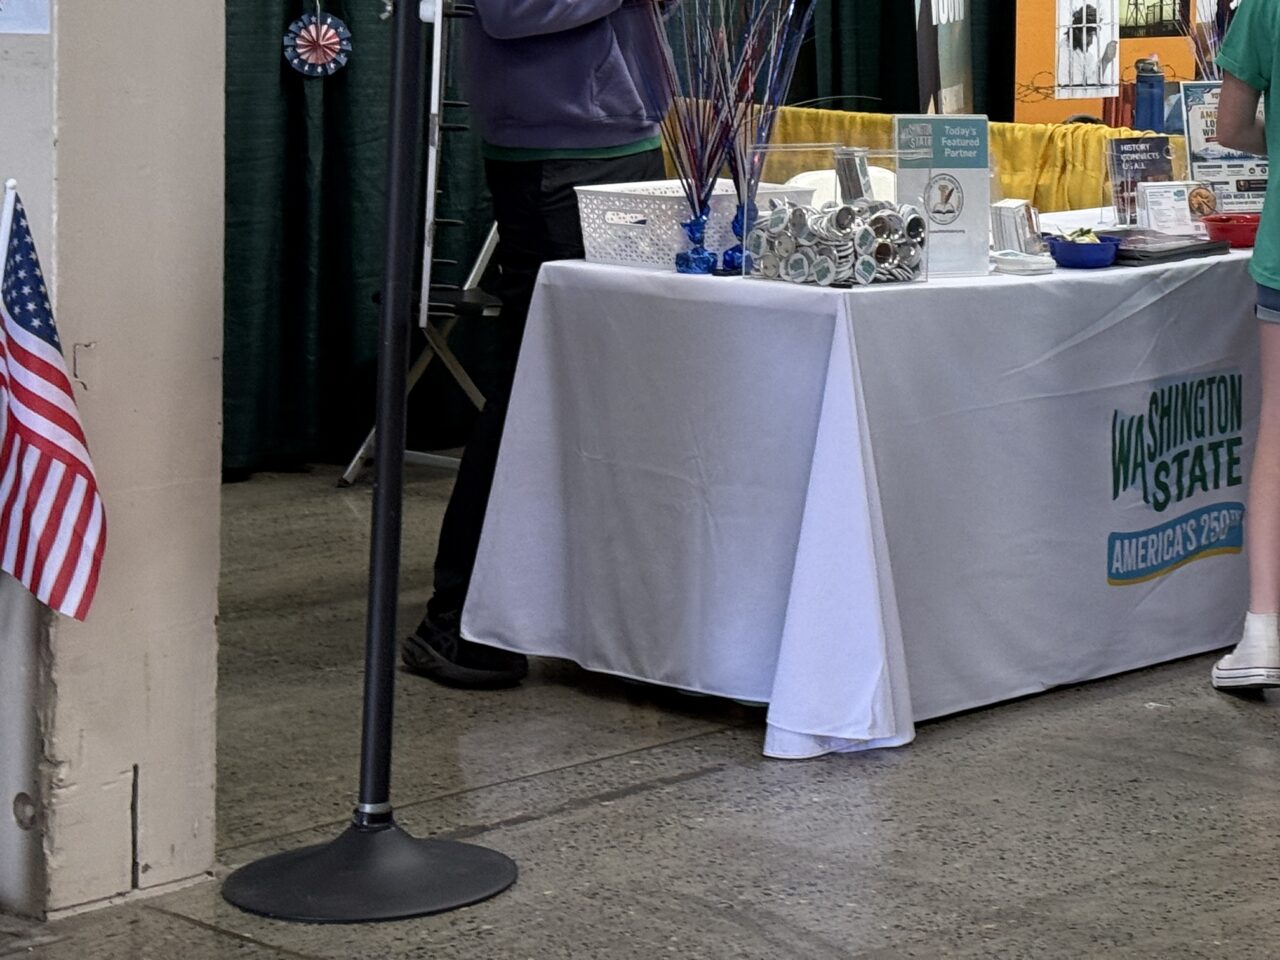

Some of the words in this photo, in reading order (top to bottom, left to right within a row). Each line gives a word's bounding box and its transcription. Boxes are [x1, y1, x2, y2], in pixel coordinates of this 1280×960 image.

[941, 137, 980, 147] Featured
[944, 125, 977, 137] Today's
[944, 148, 978, 158] Partner
[1111, 374, 1243, 505] WASHINGTON
[1152, 436, 1243, 513] STATE
[1111, 518, 1197, 574] AMERICA'S
